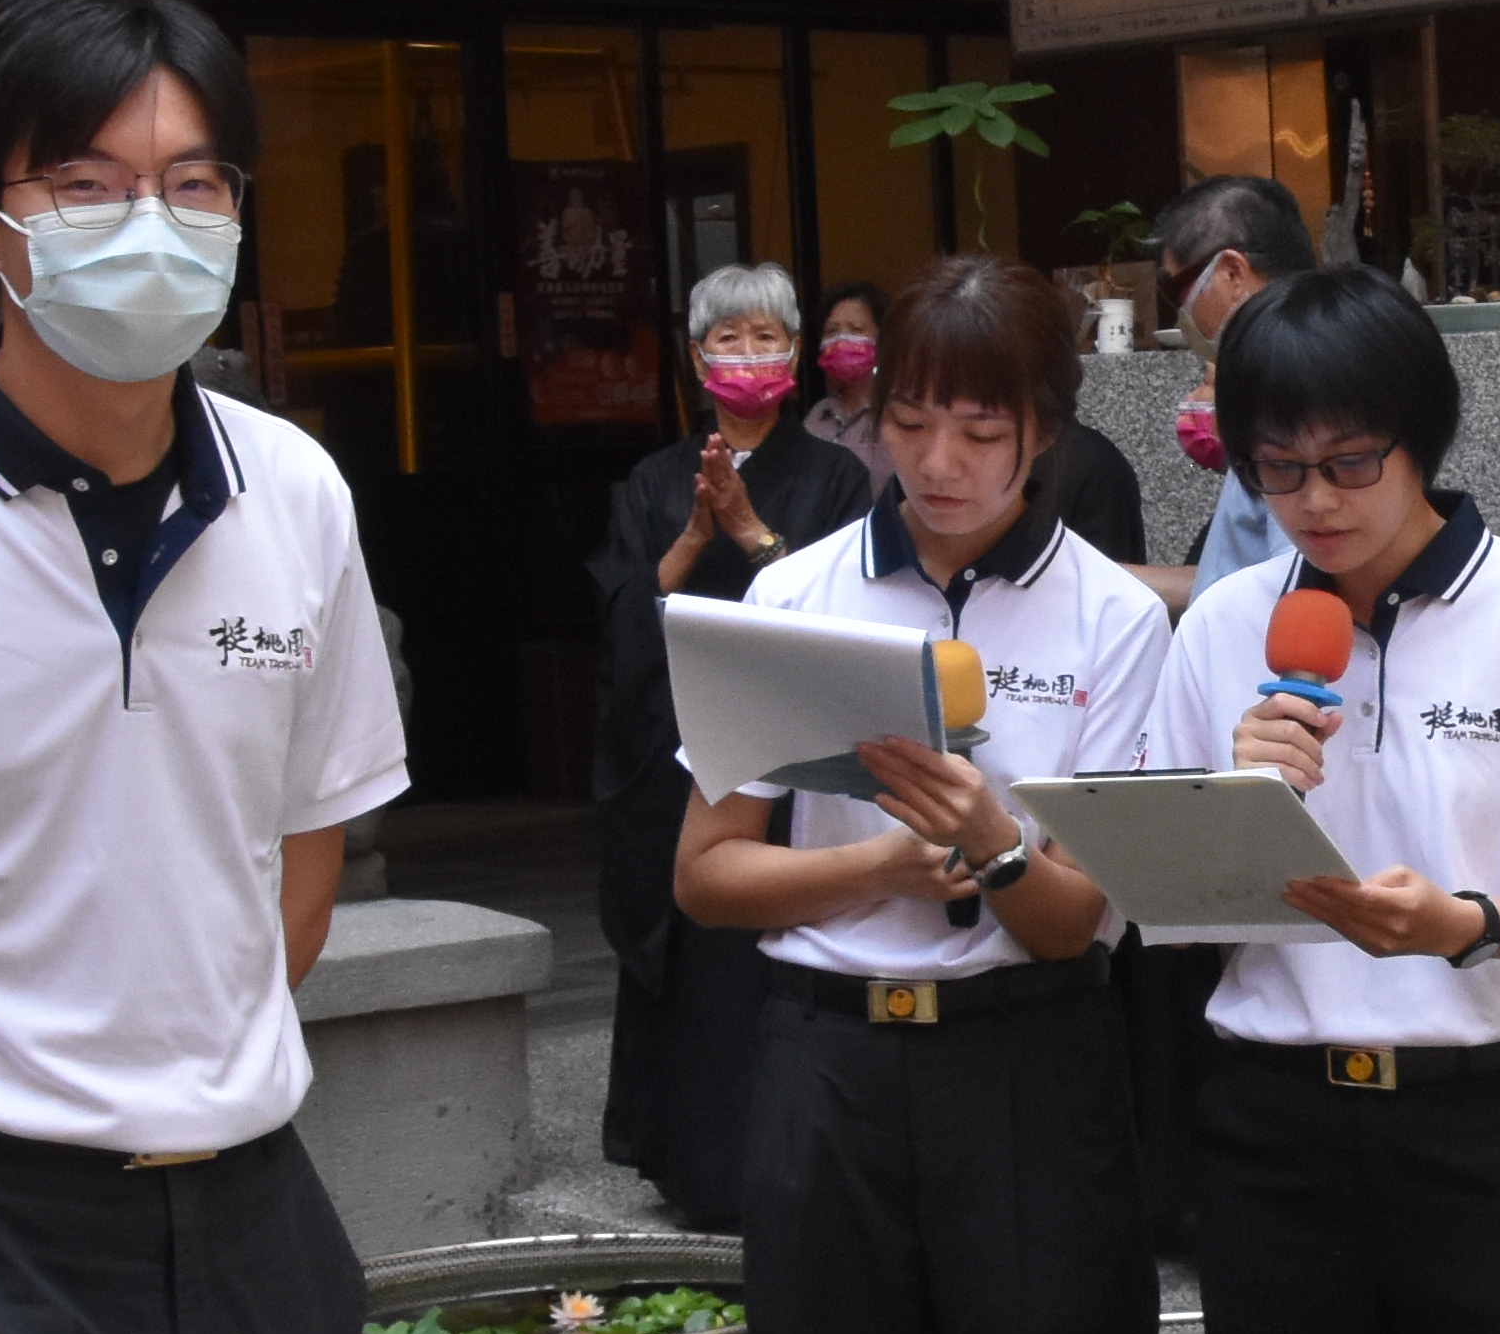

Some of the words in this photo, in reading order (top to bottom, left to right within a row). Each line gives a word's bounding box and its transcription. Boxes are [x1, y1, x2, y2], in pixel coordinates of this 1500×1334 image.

[209, 616, 304, 666] 挺桃園
[986, 664, 1075, 698] 挺桃園
